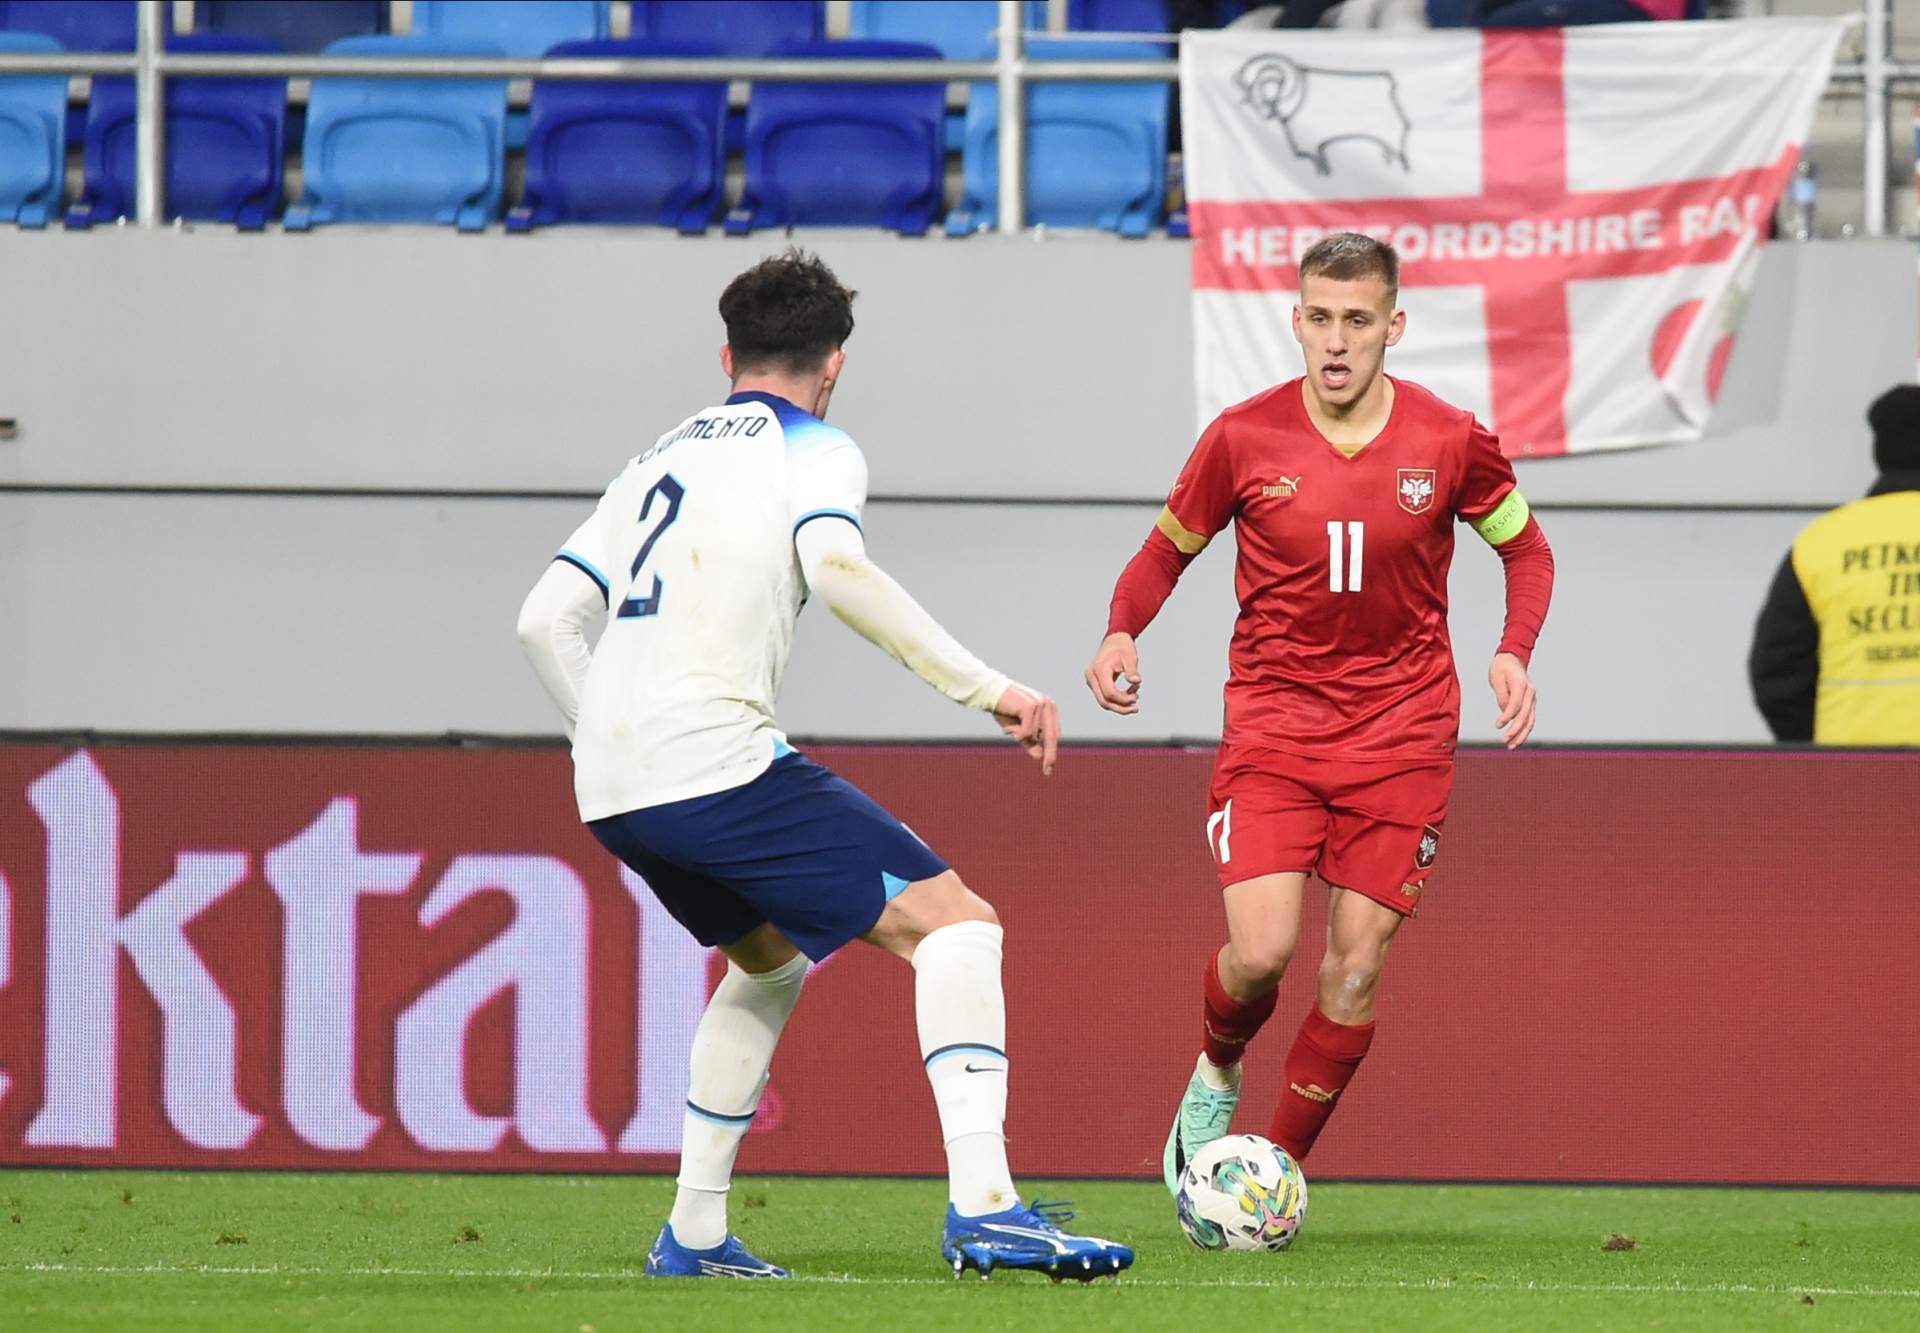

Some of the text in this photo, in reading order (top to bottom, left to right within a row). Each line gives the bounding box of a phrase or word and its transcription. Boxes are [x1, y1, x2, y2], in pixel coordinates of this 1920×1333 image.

[1221, 208, 1664, 266] HERORDSHIRE
[1262, 485, 1291, 497] PUMA
[615, 471, 686, 618] 2
[1327, 520, 1364, 593] 11
